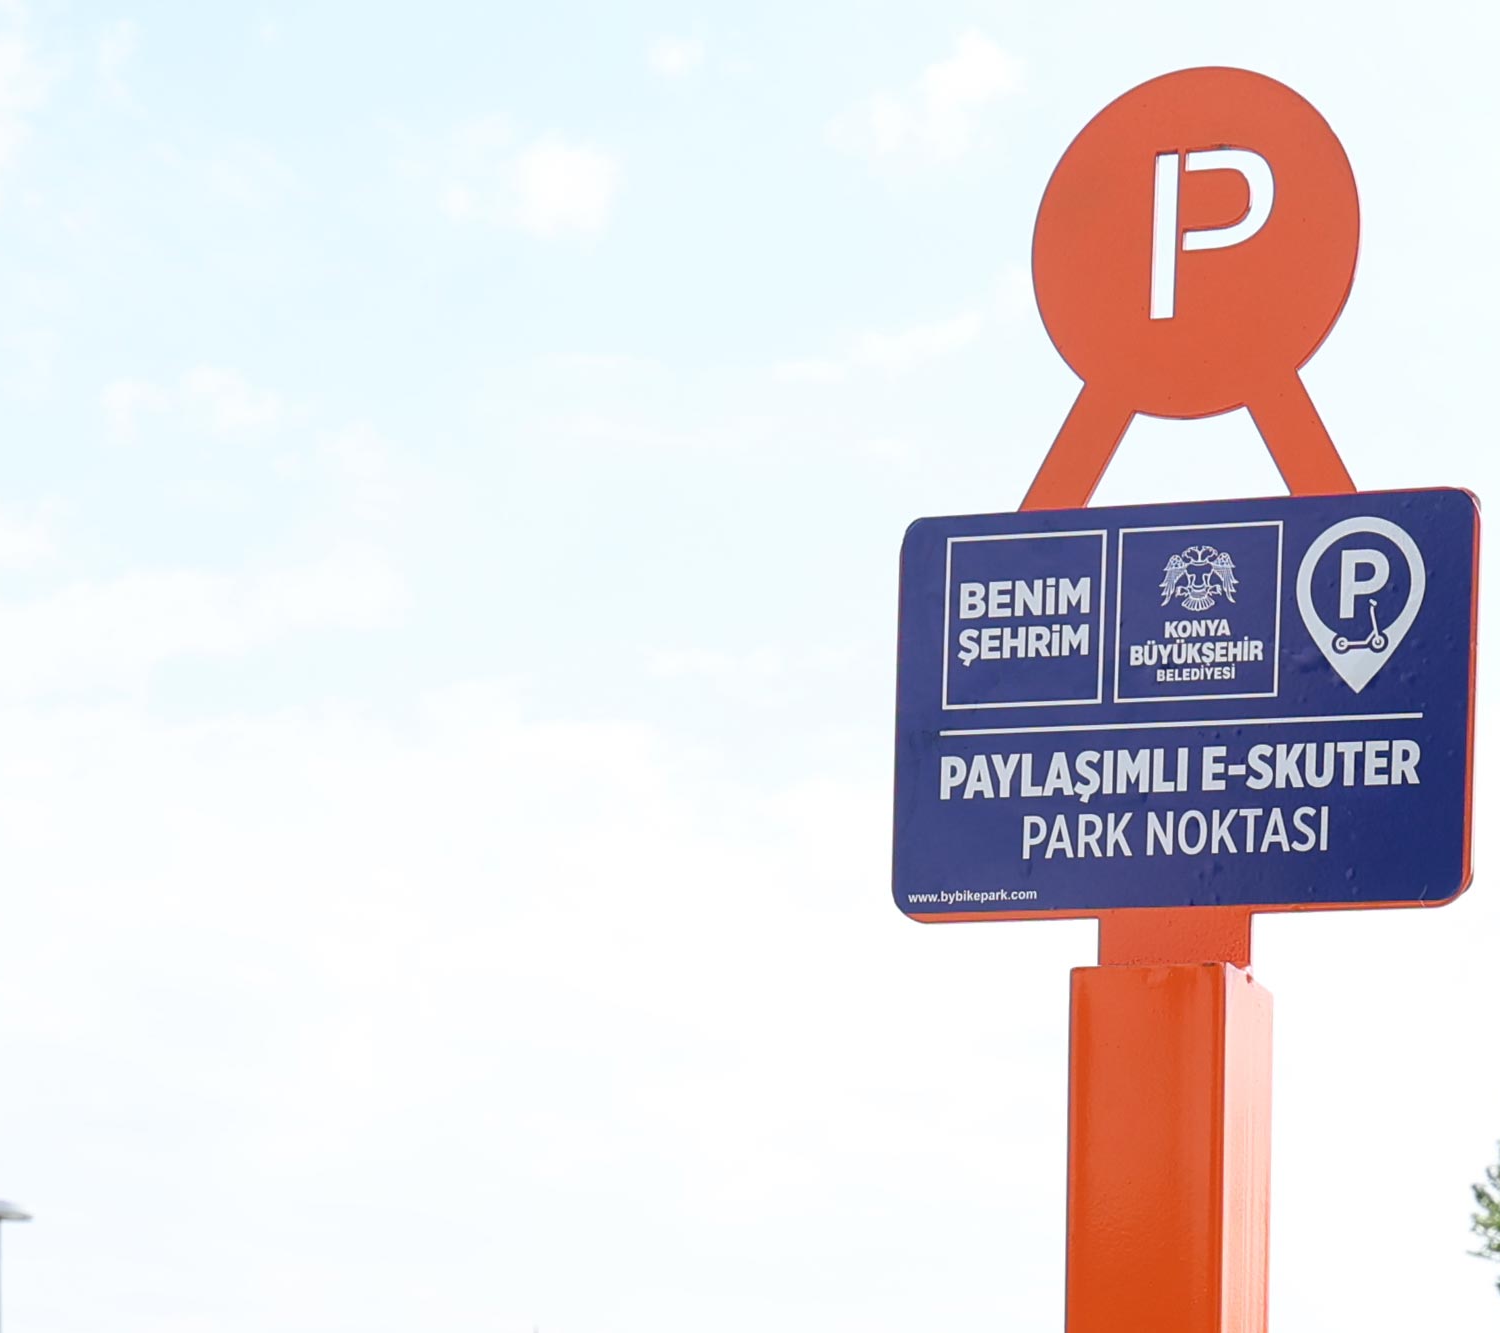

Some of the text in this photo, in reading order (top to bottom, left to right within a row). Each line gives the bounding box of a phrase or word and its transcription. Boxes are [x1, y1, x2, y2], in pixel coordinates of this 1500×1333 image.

[1150, 146, 1277, 320] P
[1339, 549, 1390, 619] P
[1164, 618, 1232, 639] KONYA
[1129, 635, 1264, 667] BÜYÜKŞEHİR
[1156, 663, 1236, 682] BELEDİYESİ
[939, 739, 1421, 804] PAYLAŞIMLI E-SKUTER
[1022, 806, 1329, 860] PARK NOKTASI
[907, 888, 1037, 905] www.bybikepark.com
